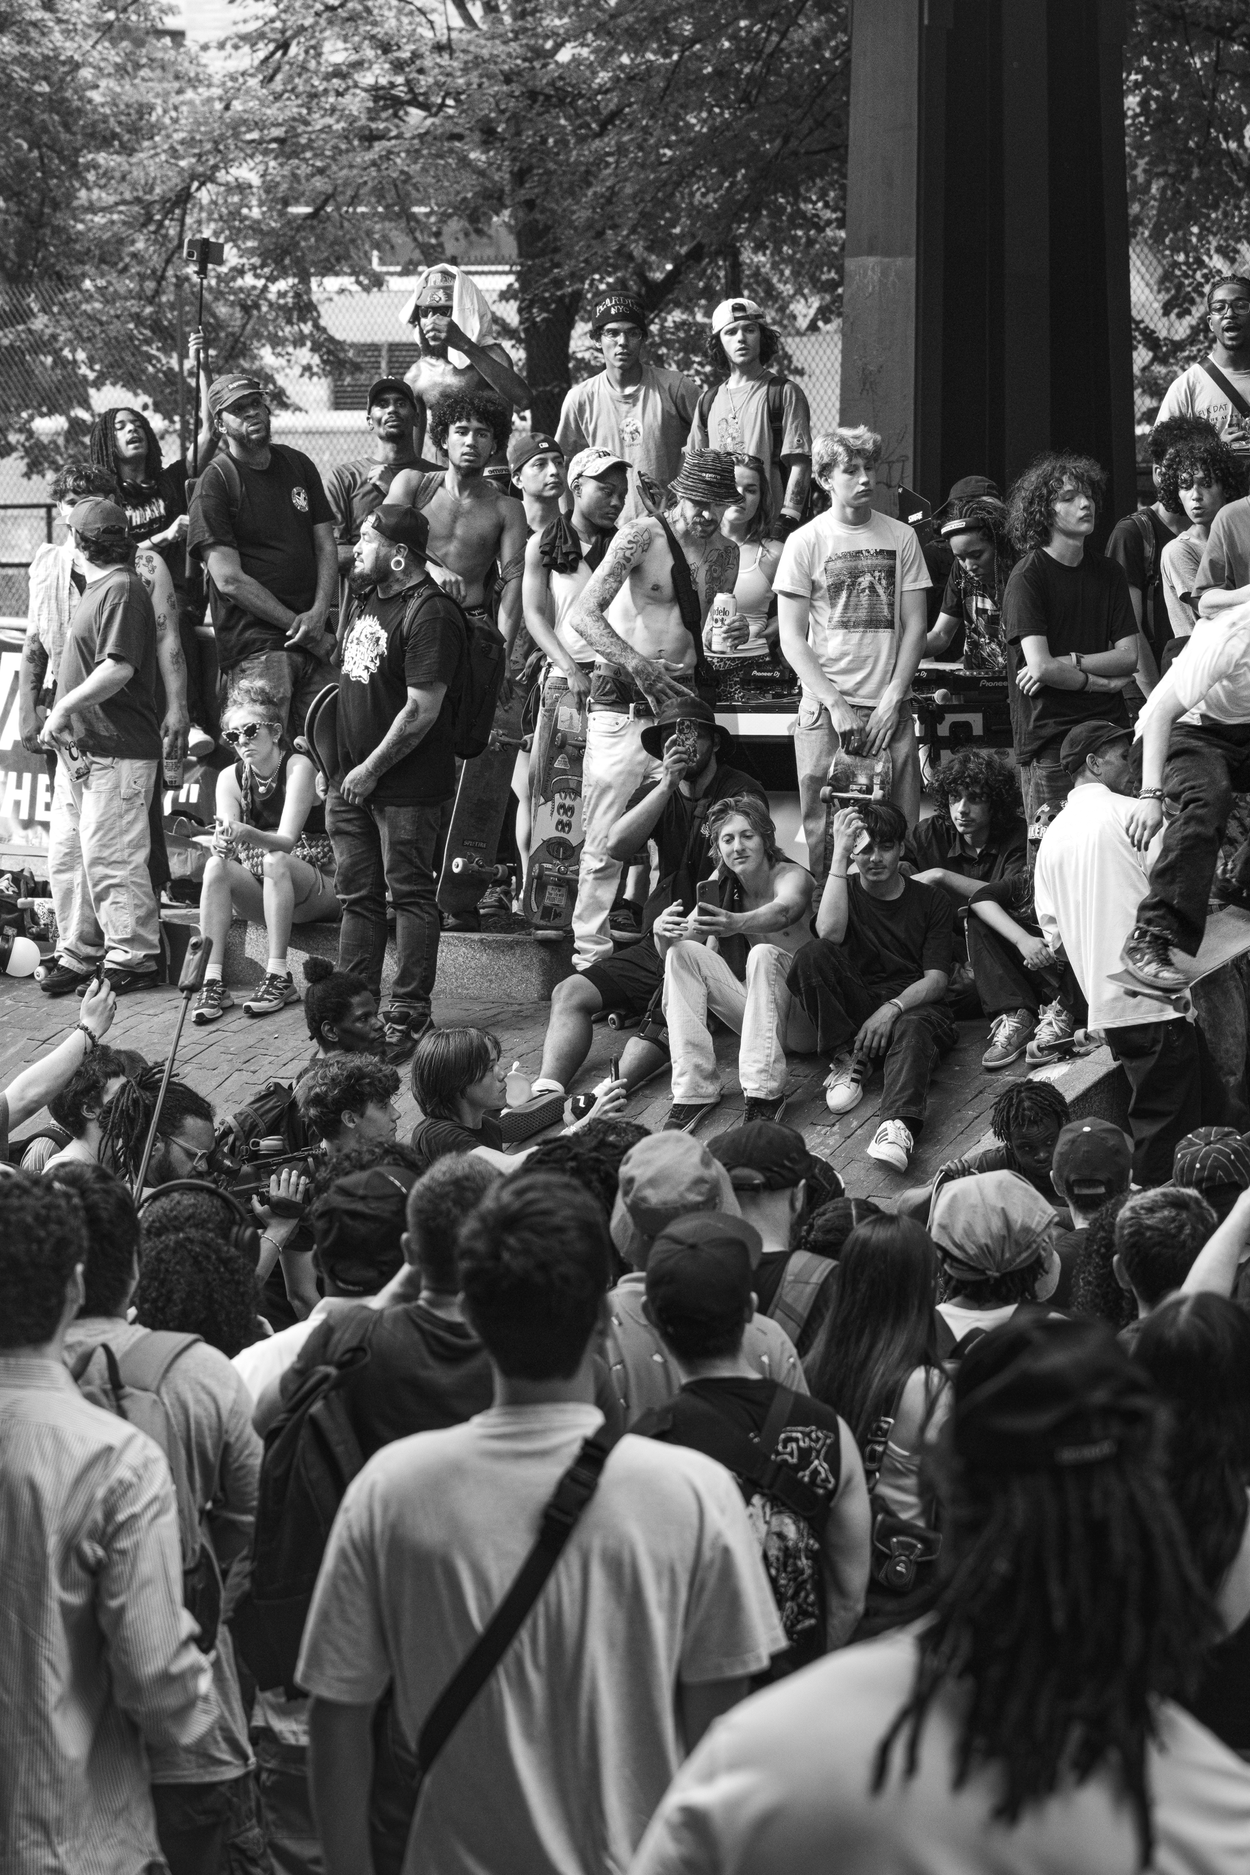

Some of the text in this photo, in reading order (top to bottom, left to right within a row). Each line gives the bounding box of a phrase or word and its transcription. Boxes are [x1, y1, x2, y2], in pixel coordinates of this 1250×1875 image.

[596, 296, 645, 318] HARDIE
[610, 305, 630, 315] NYC
[1212, 403, 1228, 413] DAT
[713, 607, 730, 617] delo
[979, 679, 1008, 687] Pionee
